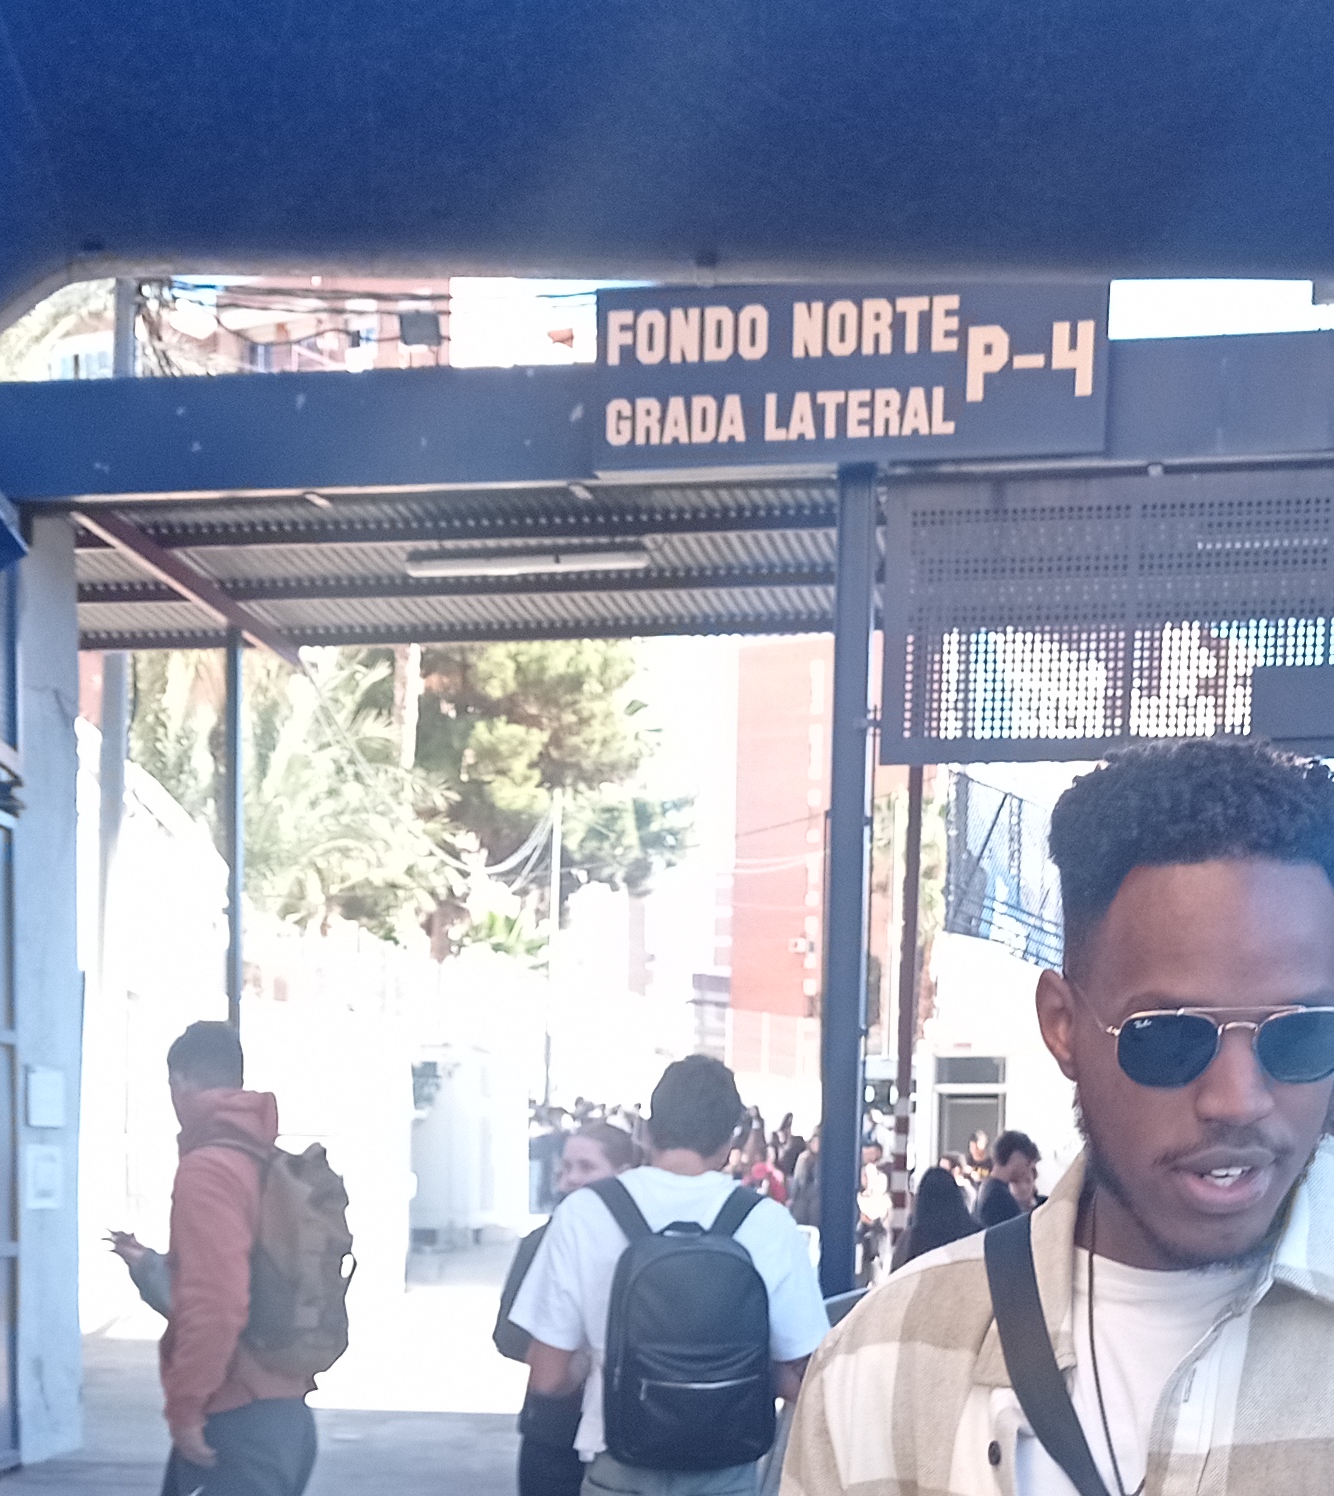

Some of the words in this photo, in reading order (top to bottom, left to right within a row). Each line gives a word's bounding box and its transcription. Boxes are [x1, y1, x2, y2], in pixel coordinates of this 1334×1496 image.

[606, 304, 768, 366] FONDO
[792, 294, 961, 359] NORTE
[966, 319, 1095, 402] P-4
[605, 394, 747, 447] GRADA
[764, 386, 956, 442] LATERAL
